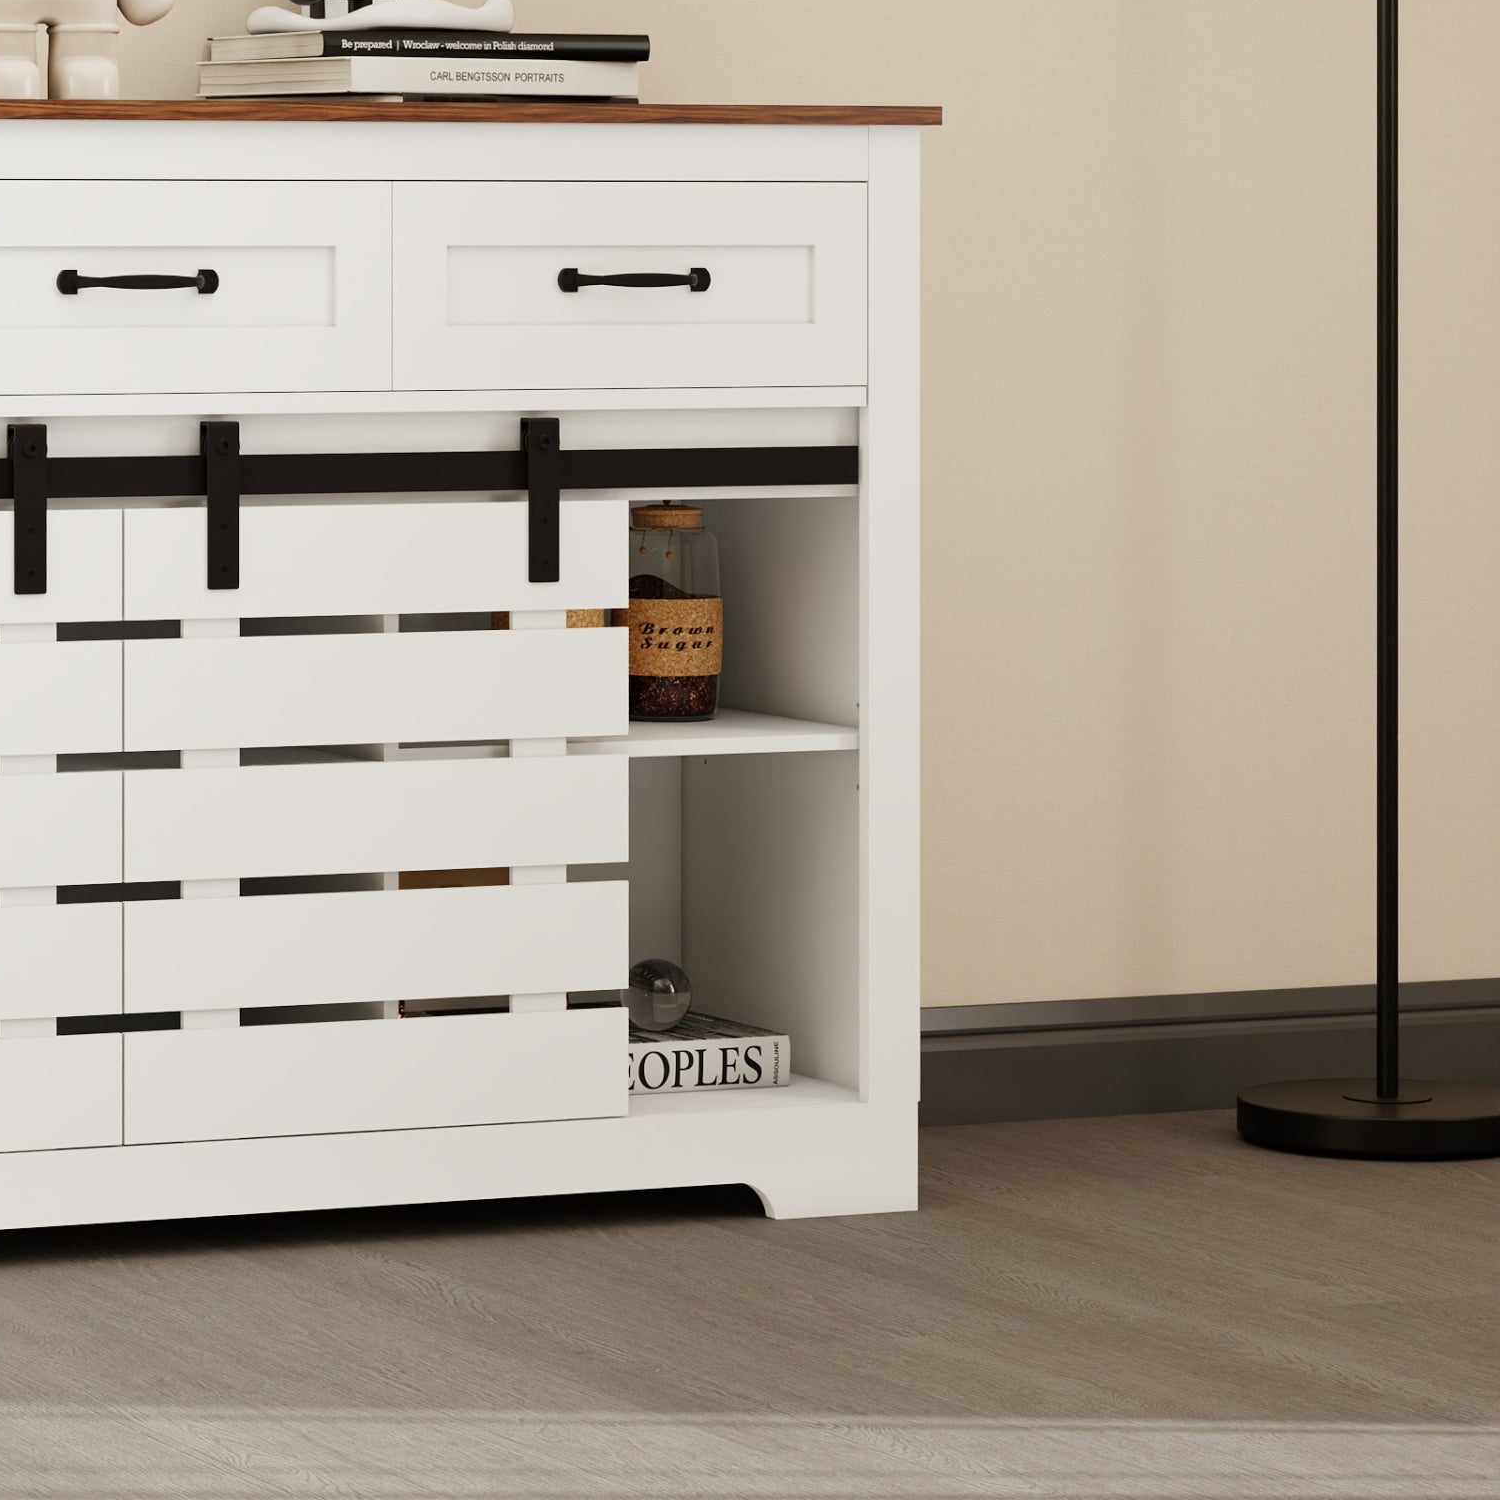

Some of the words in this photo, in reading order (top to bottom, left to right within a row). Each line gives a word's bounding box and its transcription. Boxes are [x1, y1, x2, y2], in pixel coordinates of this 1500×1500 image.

[341, 39, 353, 49] Be
[353, 40, 392, 51] prepared
[445, 41, 483, 51] welcome
[483, 41, 492, 51] in
[492, 41, 516, 52] Polish
[517, 41, 555, 52] diamond
[430, 71, 454, 81] CARL
[455, 71, 511, 82] BENGTSSON
[515, 72, 564, 84] PORTRAITS
[638, 621, 714, 635] Brown
[640, 637, 713, 652] Sugar
